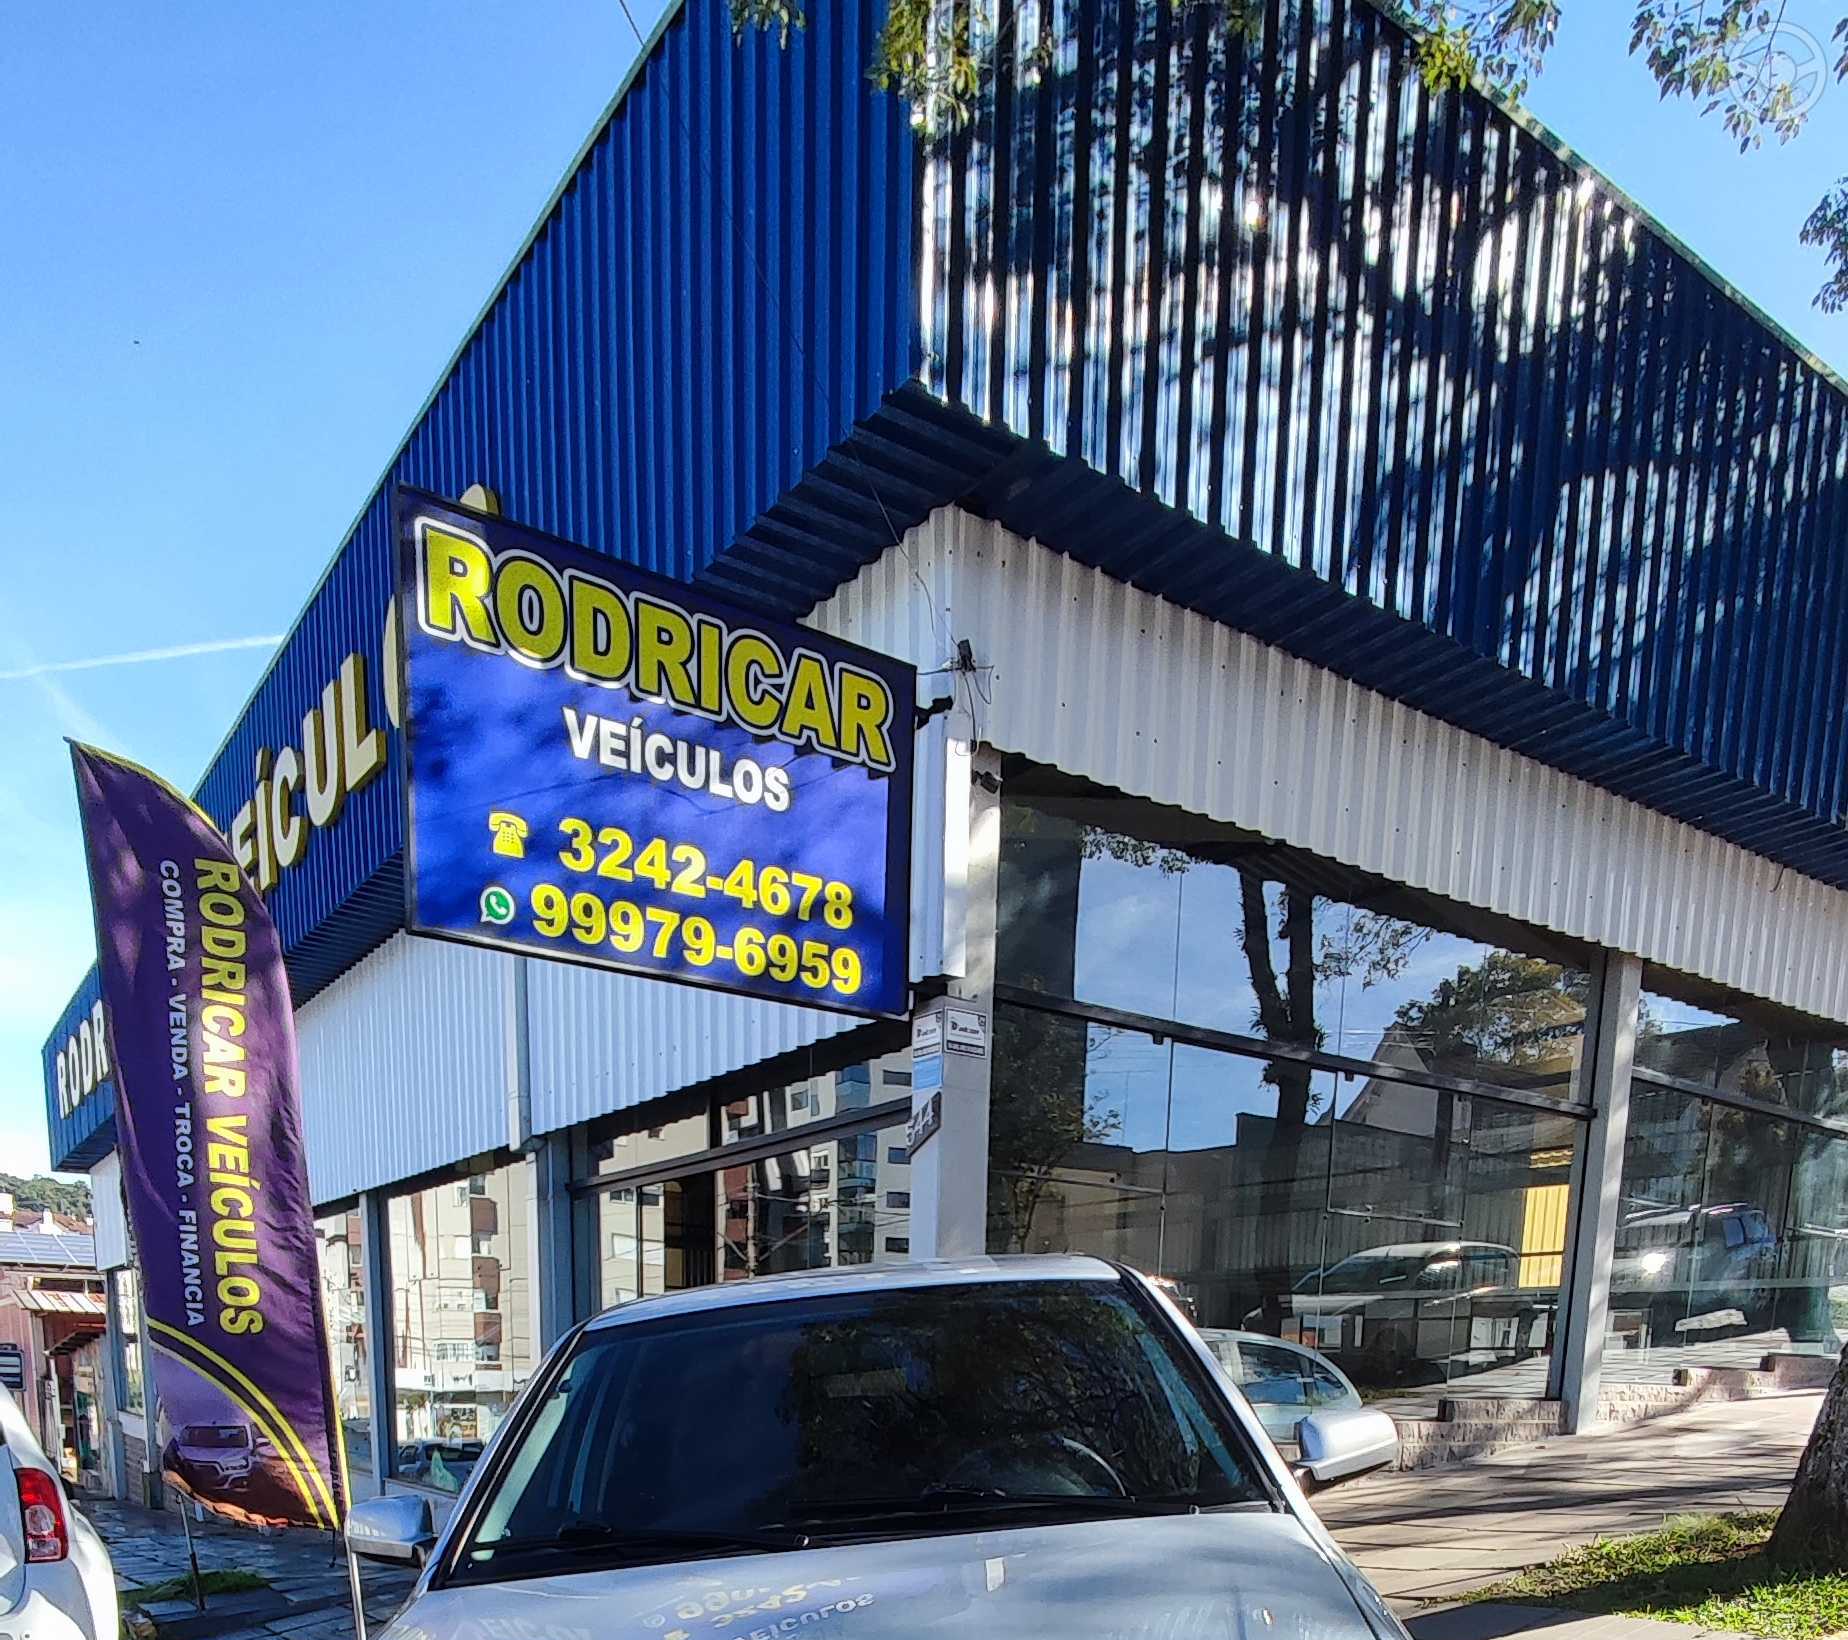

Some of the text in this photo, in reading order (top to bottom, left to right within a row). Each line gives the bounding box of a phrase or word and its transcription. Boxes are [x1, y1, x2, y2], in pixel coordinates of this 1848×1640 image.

[415, 516, 897, 773] RODRICAR
[562, 708, 791, 812] VEÍCULOS
[160, 859, 186, 971] COMPRA
[558, 816, 854, 931] 3242-4678
[530, 883, 862, 995] 99979-6959
[168, 994, 189, 1081] VENDA
[173, 1102, 195, 1188] TROCA
[195, 857, 264, 1335] RODRICAR VEÍCULOS
[178, 1209, 205, 1327] FINANCIA
